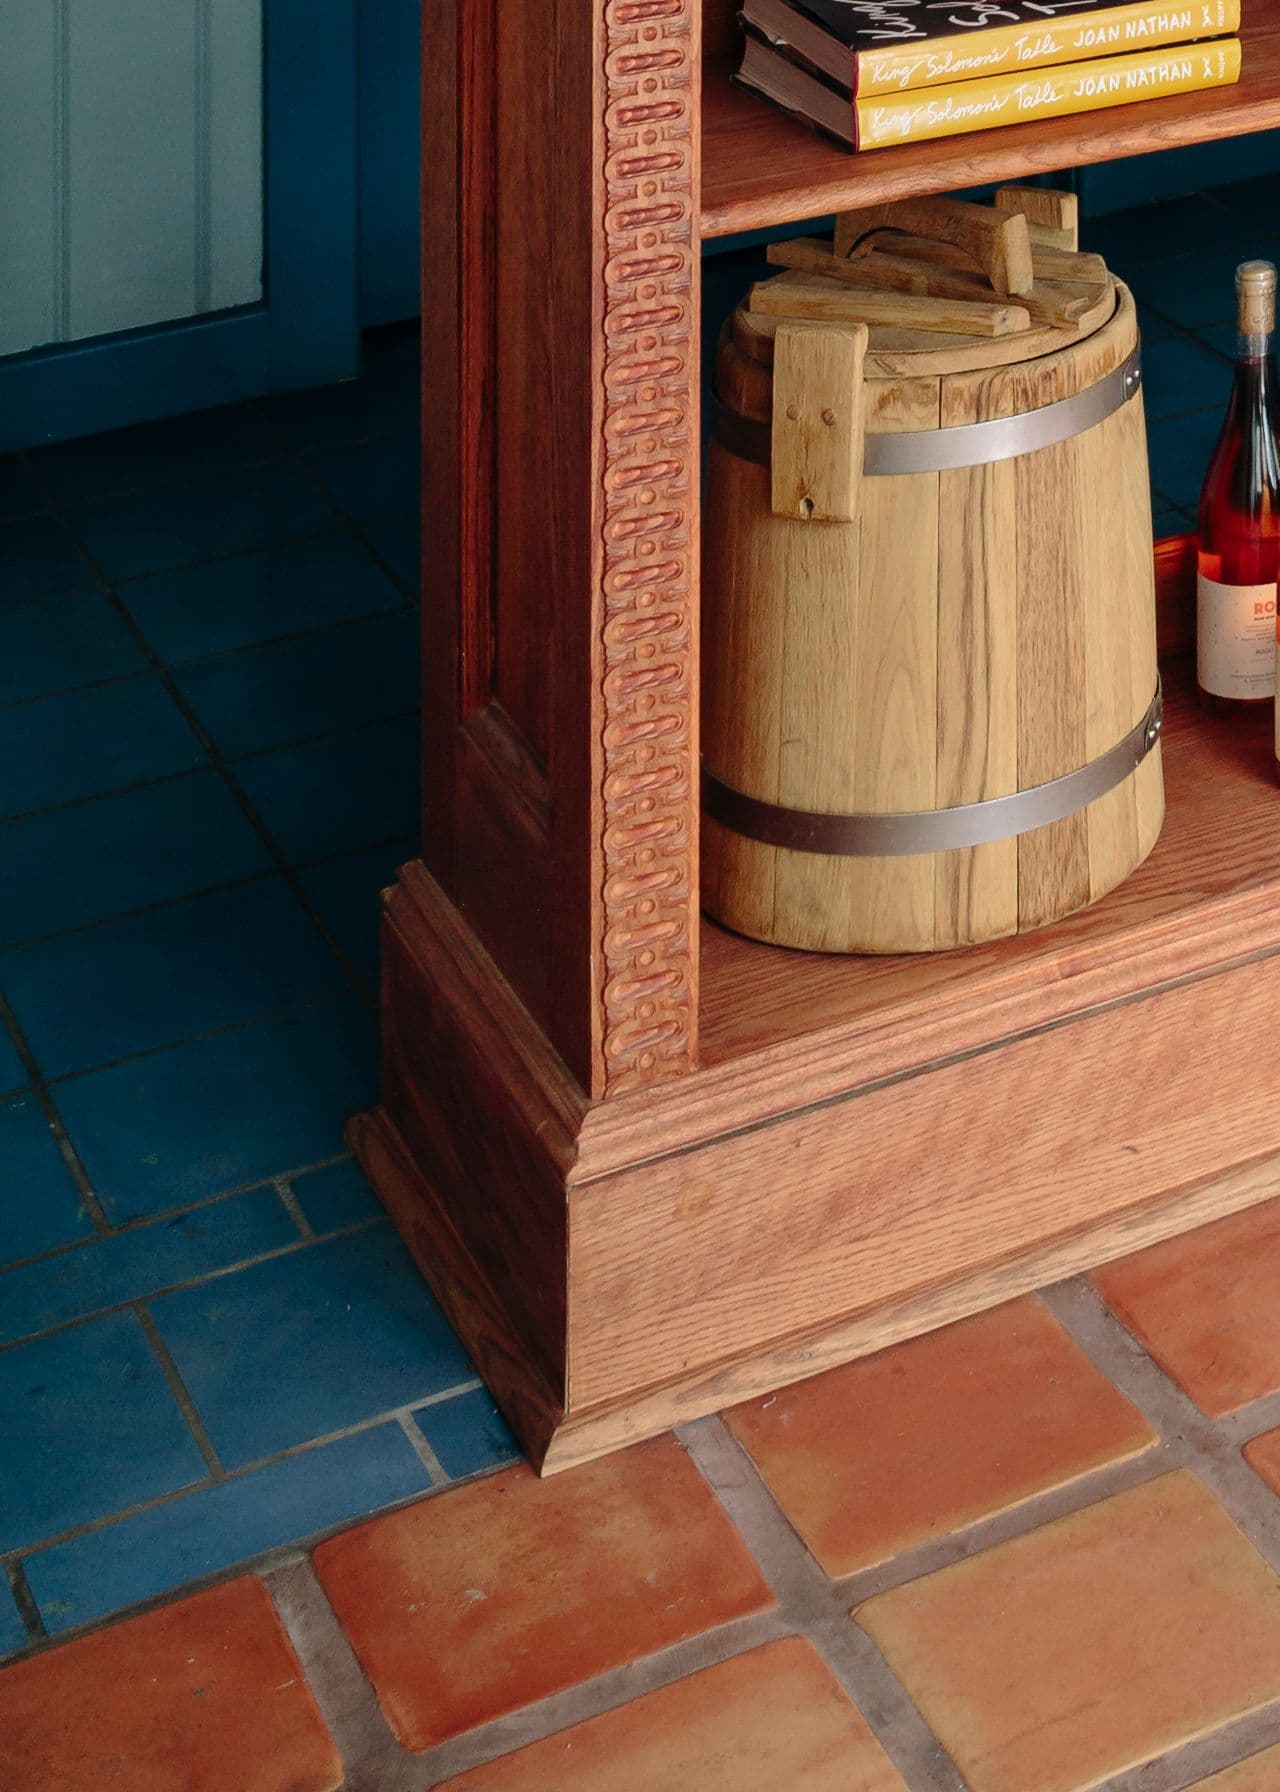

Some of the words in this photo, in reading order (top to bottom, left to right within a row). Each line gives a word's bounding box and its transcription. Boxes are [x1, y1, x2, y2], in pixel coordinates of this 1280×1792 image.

[872, 59, 925, 87] King
[926, 48, 1008, 81] Solomon's
[1015, 33, 1064, 62] Table
[1073, 25, 1120, 49] JOAN
[1125, 11, 1192, 39] NATHAN
[871, 107, 925, 135] King
[927, 94, 1009, 126] Solomon's
[1015, 81, 1065, 111] Table
[1074, 74, 1120, 97] JOAN
[1125, 61, 1192, 89] NATHAN
